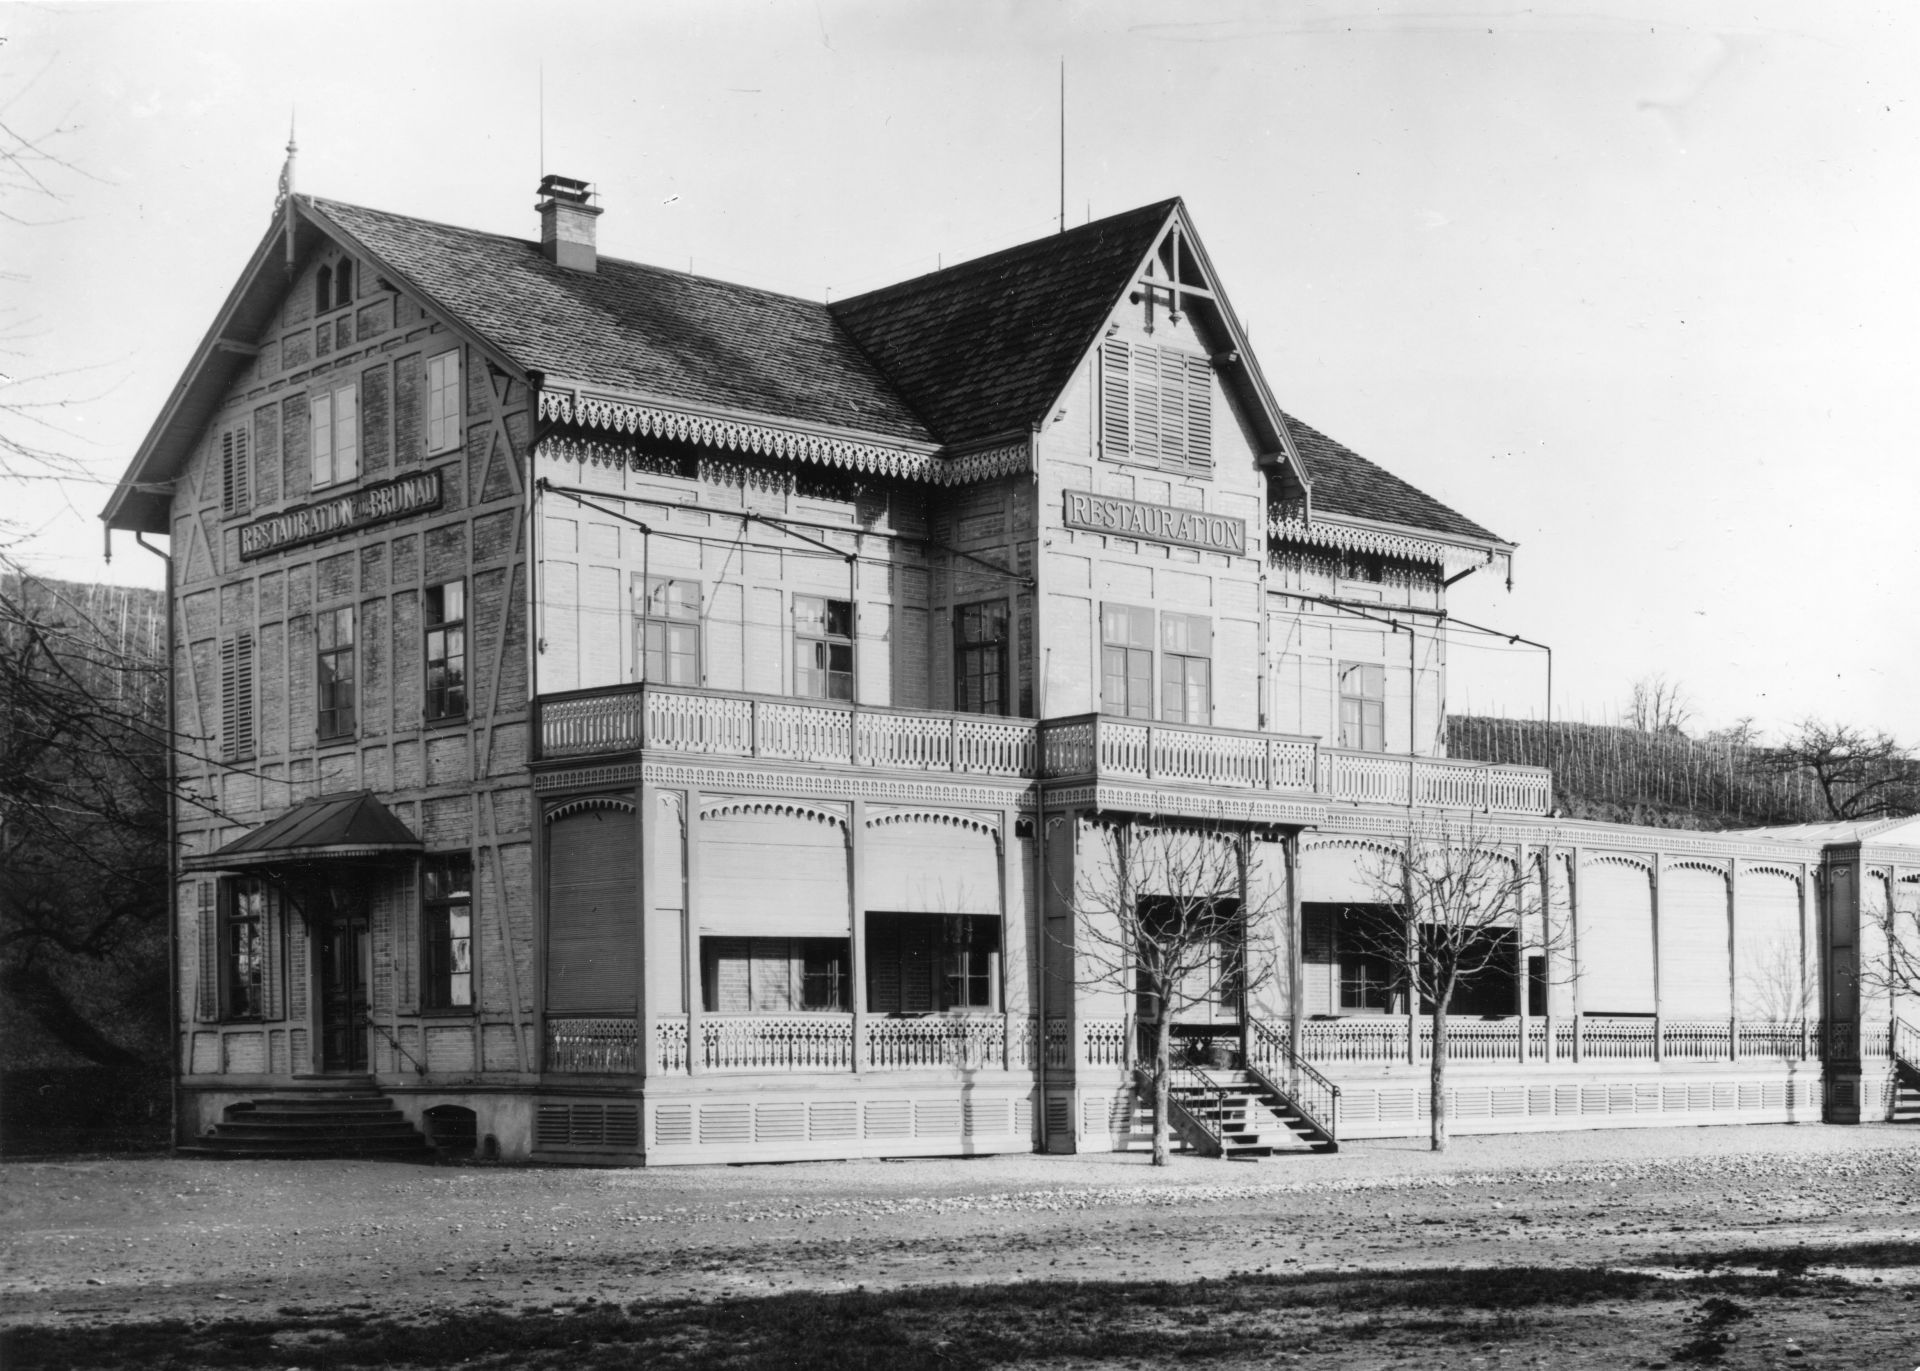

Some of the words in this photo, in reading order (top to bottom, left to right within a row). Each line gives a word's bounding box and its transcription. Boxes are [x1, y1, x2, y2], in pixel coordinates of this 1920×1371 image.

[242, 498, 353, 553] RESTAURATION
[370, 474, 438, 518] BRUNAU
[1071, 494, 1240, 549] RESTAURATION
